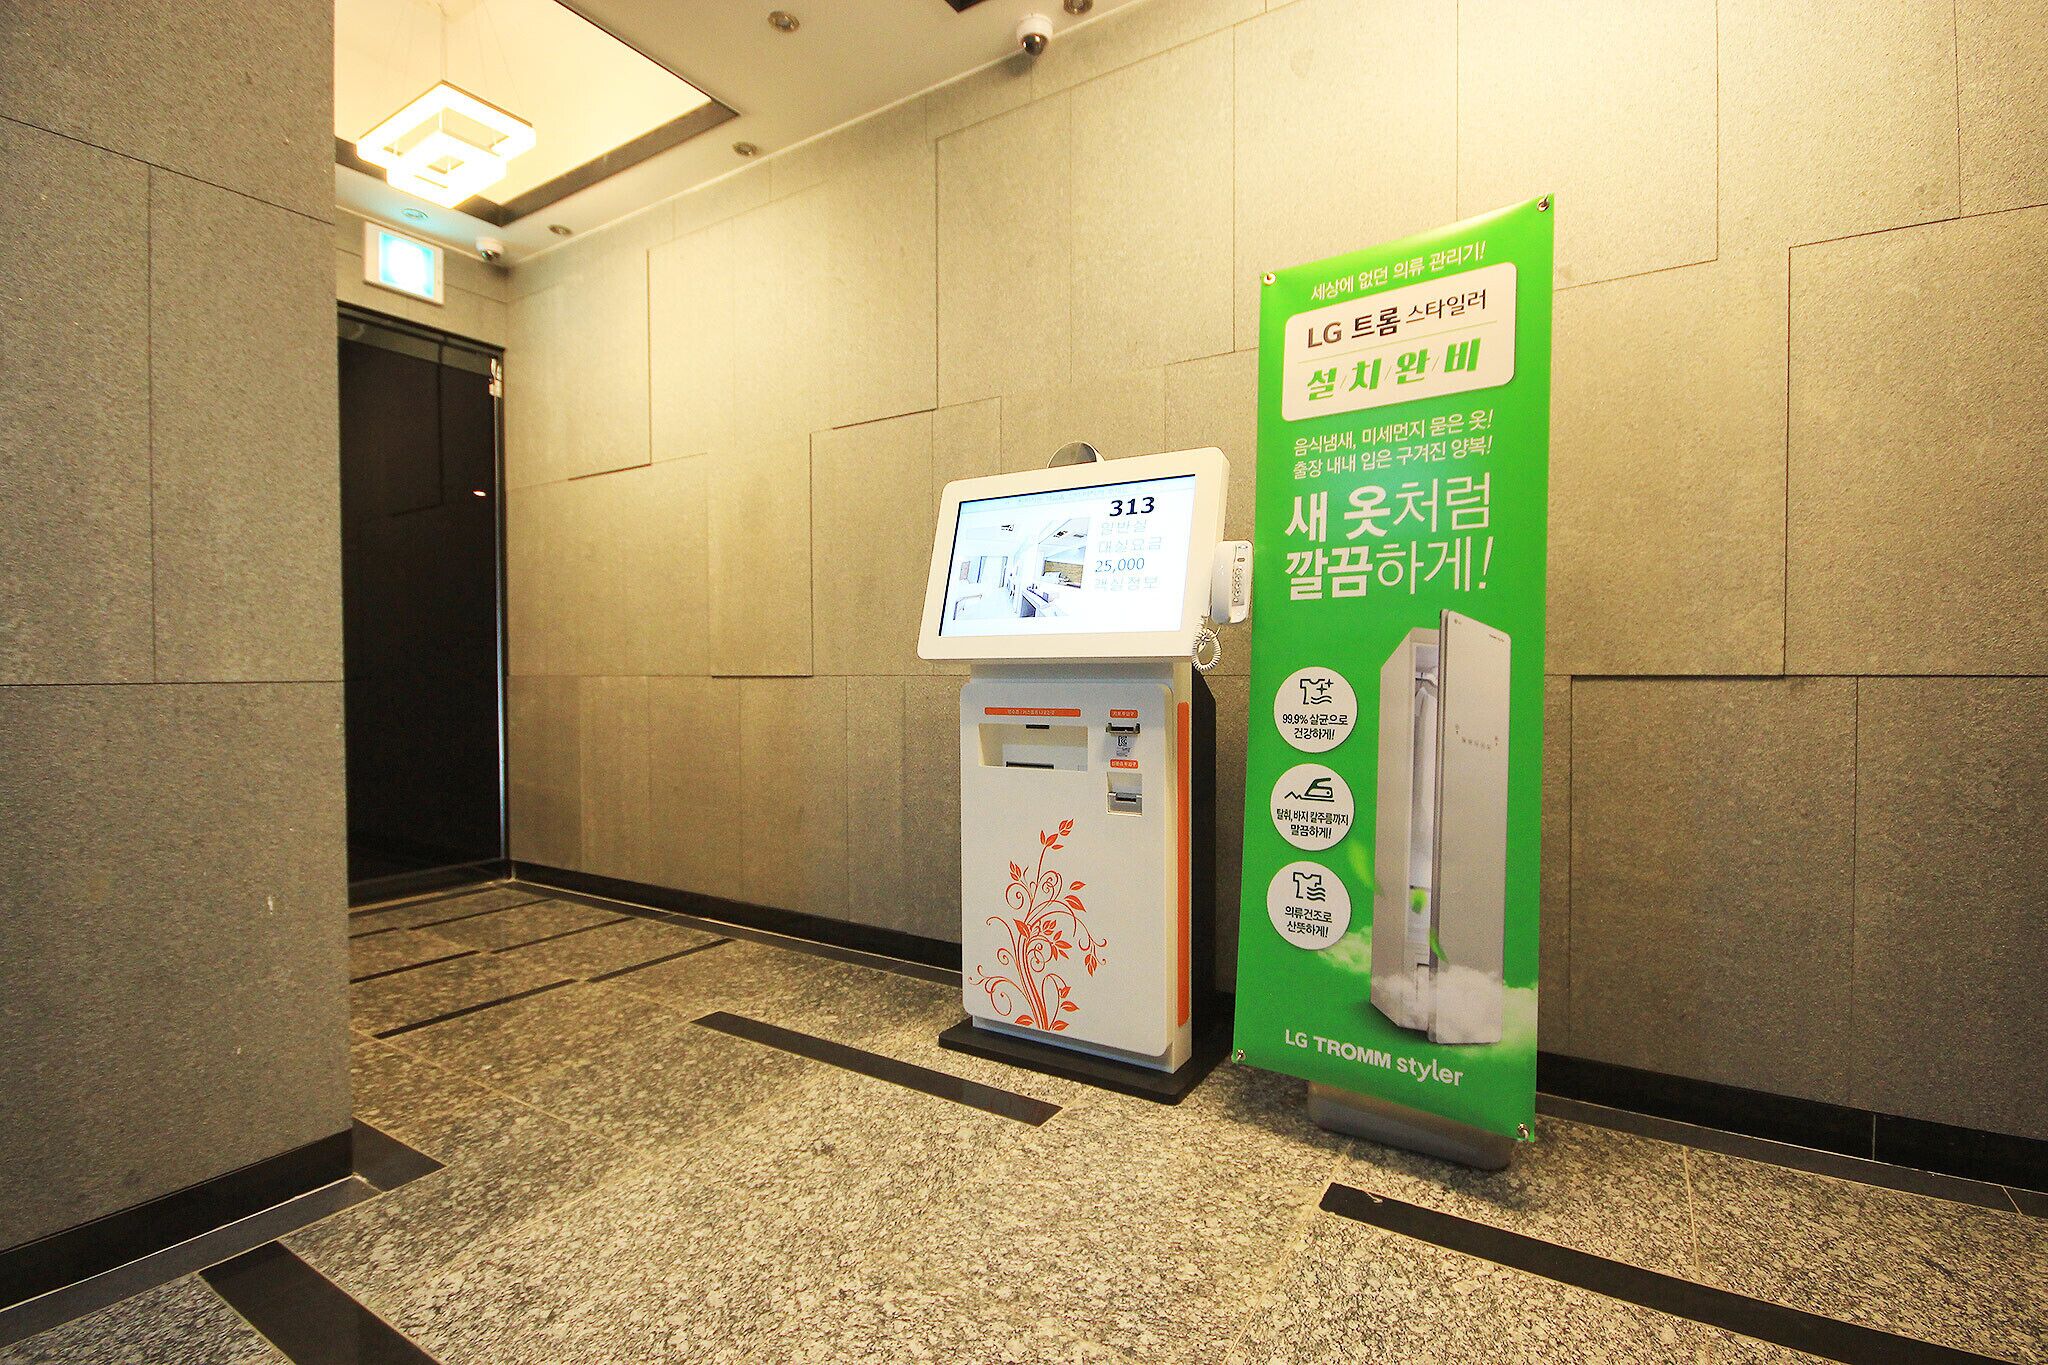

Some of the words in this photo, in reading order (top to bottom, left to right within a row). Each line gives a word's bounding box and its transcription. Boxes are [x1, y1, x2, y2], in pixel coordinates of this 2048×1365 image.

[1311, 275, 1354, 301] 세상에
[1358, 268, 1389, 289] 없던
[1393, 259, 1425, 280] 의류
[1429, 240, 1487, 273] 관리기!
[1307, 321, 1342, 348] LG
[1351, 306, 1401, 339] 트롬
[1405, 288, 1487, 324] 스타일러
[1294, 430, 1357, 457] 음식냄새,
[1362, 419, 1426, 445] 미세먼지
[1430, 413, 1464, 437] 묻은
[1468, 409, 1494, 432] 옷!
[1293, 459, 1323, 480] 출장
[1326, 456, 1356, 474] 내내
[1361, 449, 1393, 471] 입은
[1396, 441, 1446, 466] 구겨진
[1450, 435, 1493, 459] 양복!
[1109, 496, 1155, 517] 313
[1285, 491, 1328, 543] 새
[1343, 472, 1491, 541] 옷처럼
[1095, 557, 1145, 573] 25,000
[1285, 536, 1494, 601] 깔끔하게!
[1282, 713, 1309, 725] 99.9%
[1310, 713, 1348, 726] 살균으로
[1294, 728, 1335, 740] 건강하게!
[1287, 921, 1329, 938] 산뜻하게!
[1285, 1029, 1308, 1049] LG
[1313, 1035, 1392, 1069] TROMM
[1396, 1057, 1464, 1086] styler
